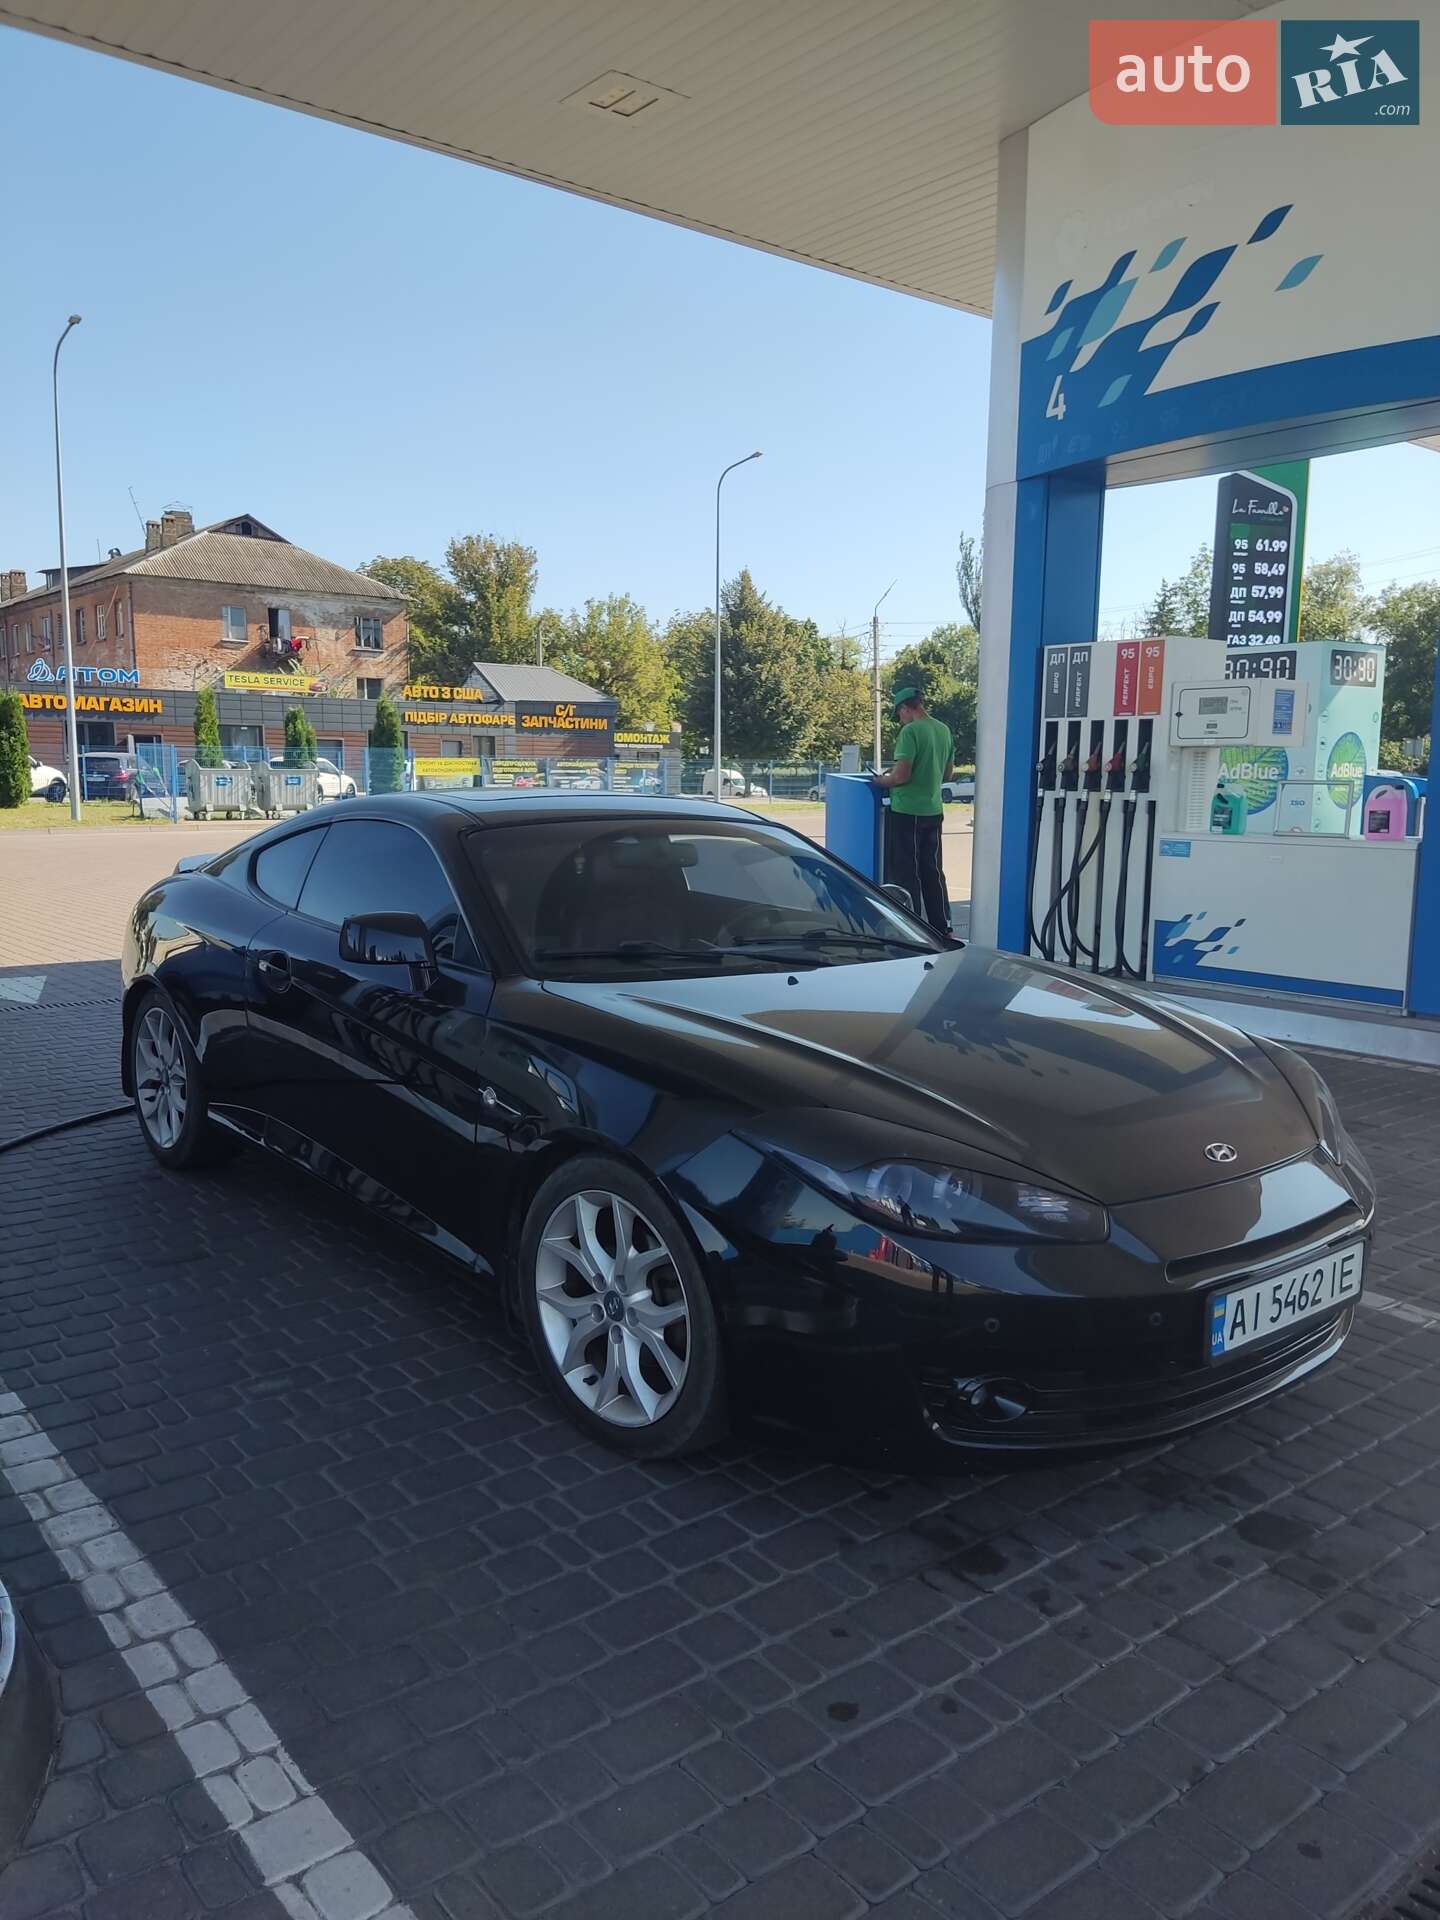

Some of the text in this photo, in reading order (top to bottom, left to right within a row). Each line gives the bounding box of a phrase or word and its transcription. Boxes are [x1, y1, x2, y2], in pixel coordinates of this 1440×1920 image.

[1045, 374, 1066, 421] 4
[1234, 539, 1248, 550] 95
[1232, 563, 1246, 574] 95
[1230, 586, 1247, 599] ДП
[1228, 610, 1245, 622] ДП
[1227, 634, 1247, 645] ГАЗ
[1072, 652, 1088, 664] ДП
[1121, 648, 1136, 659] 95
[1145, 646, 1160, 657] 95
[1049, 653, 1065, 665] ДП
[1334, 654, 1376, 683] 30:90
[228, 674, 305, 687] TESLA SERVICE
[402, 685, 438, 699] АВТО
[453, 687, 483, 700] США
[404, 711, 516, 726] ПІДБІР АВТОФАРБ
[521, 715, 608, 730] ЗАПЧАСТИНИ
[1217, 762, 1280, 780] AdBlue
[1330, 762, 1362, 778] AdBlue
[1229, 1253, 1355, 1341] AI 5462 IE
[1211, 1331, 1224, 1346] UA
